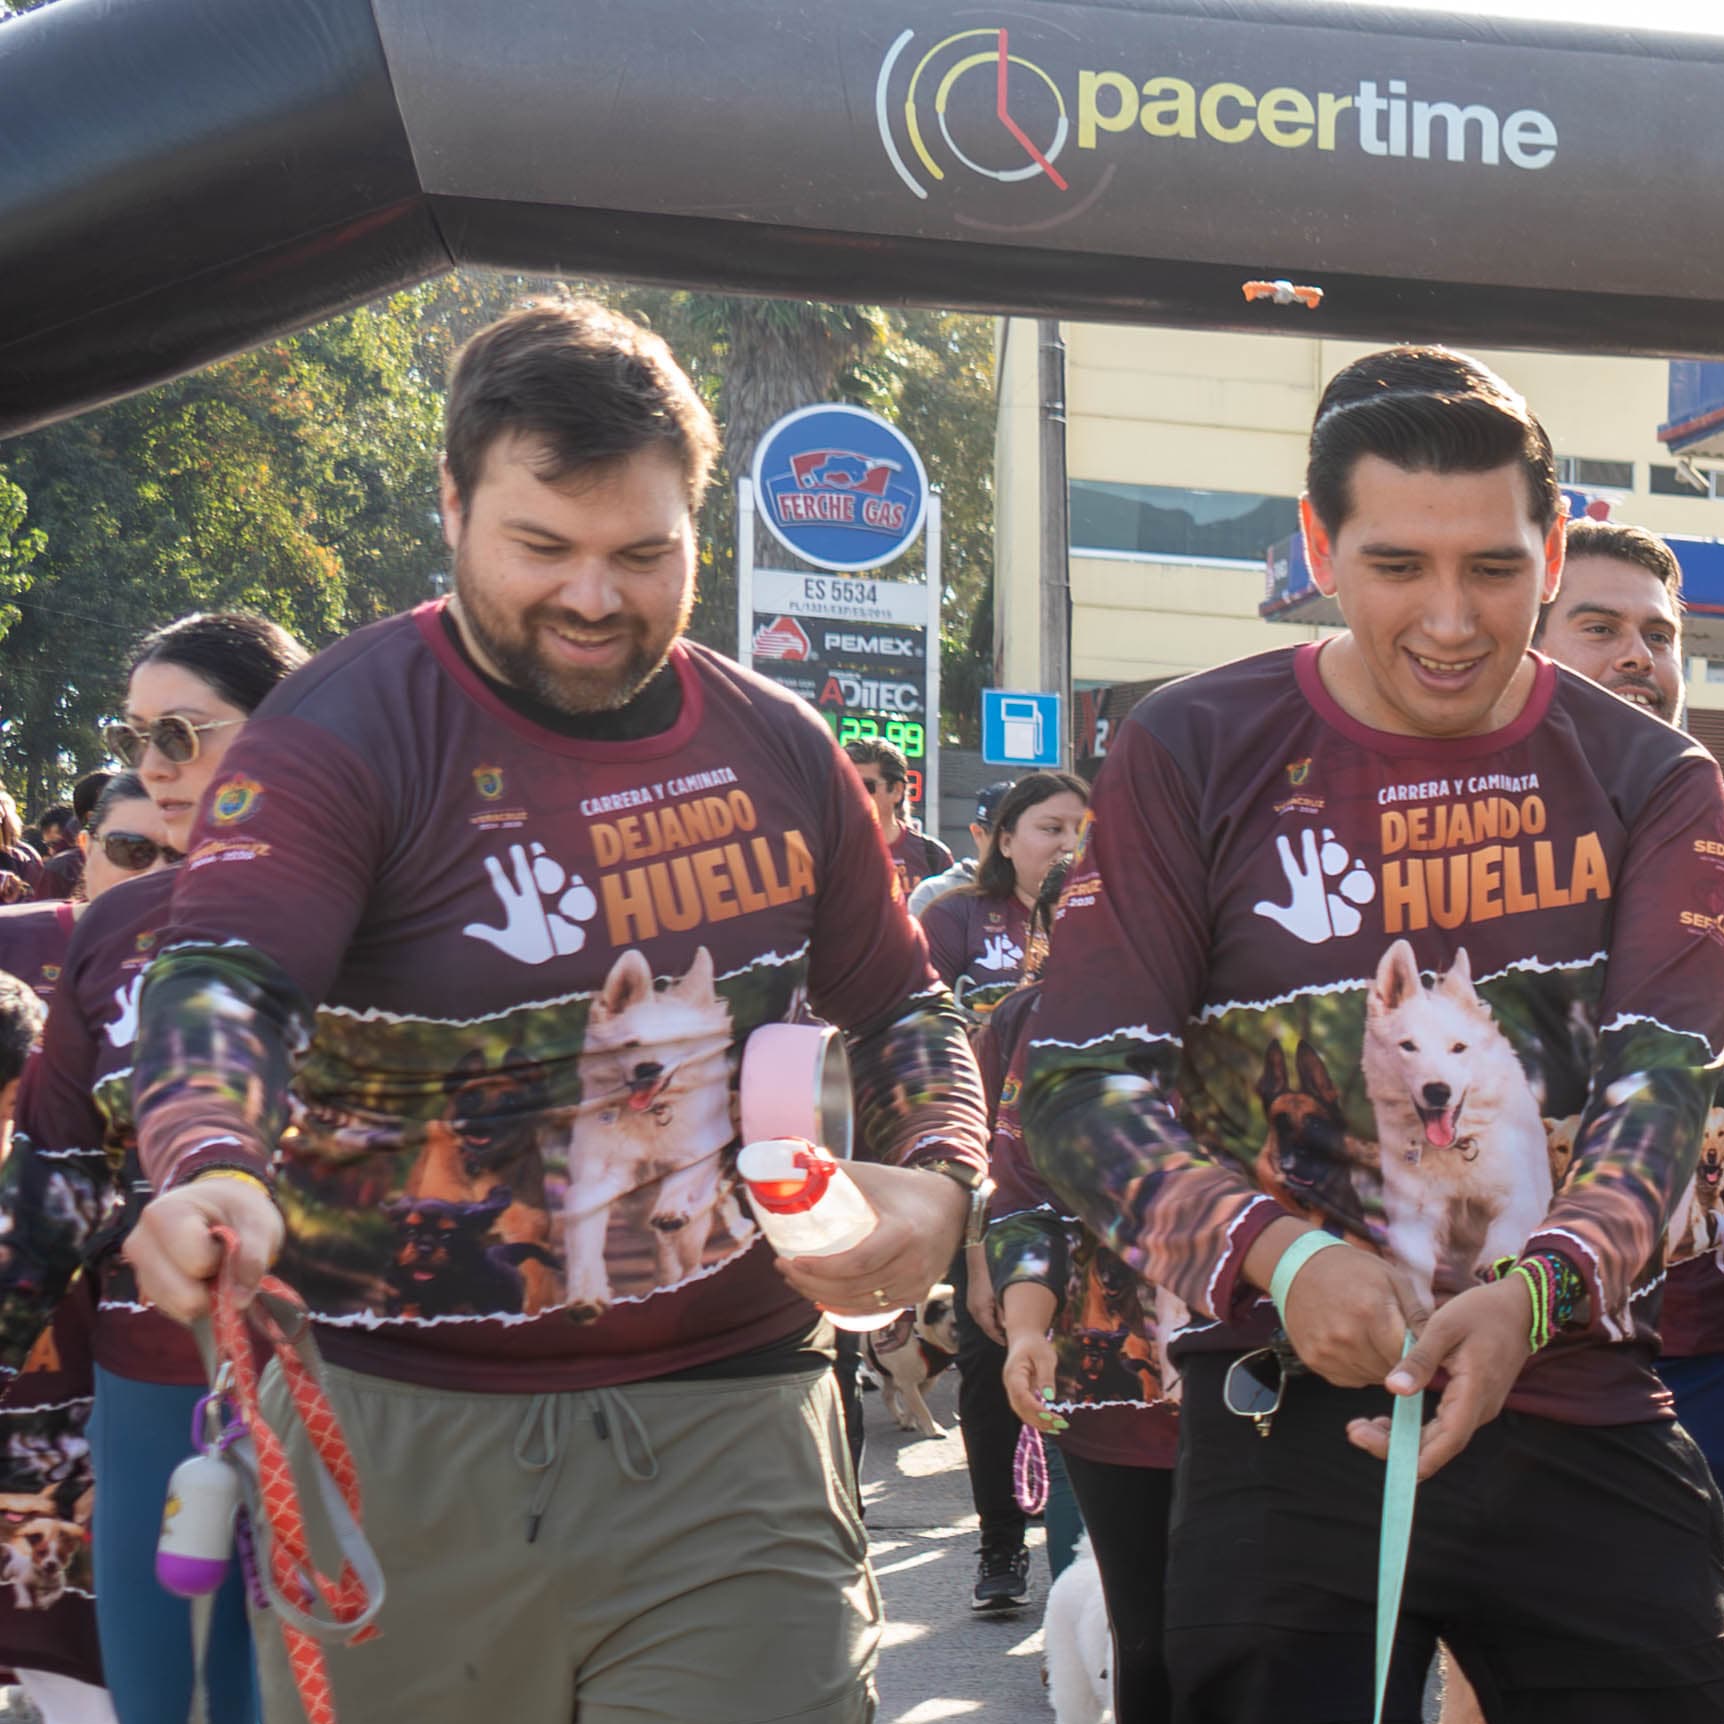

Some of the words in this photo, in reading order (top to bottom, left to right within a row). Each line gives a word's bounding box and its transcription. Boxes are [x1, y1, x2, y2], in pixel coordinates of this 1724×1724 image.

[1077, 69, 1558, 170] pacertime
[778, 493, 854, 523] FERCHE
[862, 499, 904, 529] GAS
[804, 578, 825, 600] ES
[831, 580, 877, 603] 5534
[824, 632, 913, 656] PEMEX
[580, 786, 653, 817] CARRERA
[653, 782, 666, 800] Y
[666, 766, 737, 797] CAMINATA
[1378, 779, 1449, 805] CARRERA
[1454, 778, 1465, 796] Y
[1467, 774, 1540, 795] CAMINATA
[589, 789, 758, 869] DEJANDO
[1381, 795, 1546, 855] DEJANDO
[601, 829, 816, 948] HUELLA
[1381, 831, 1611, 934] HUELLA
